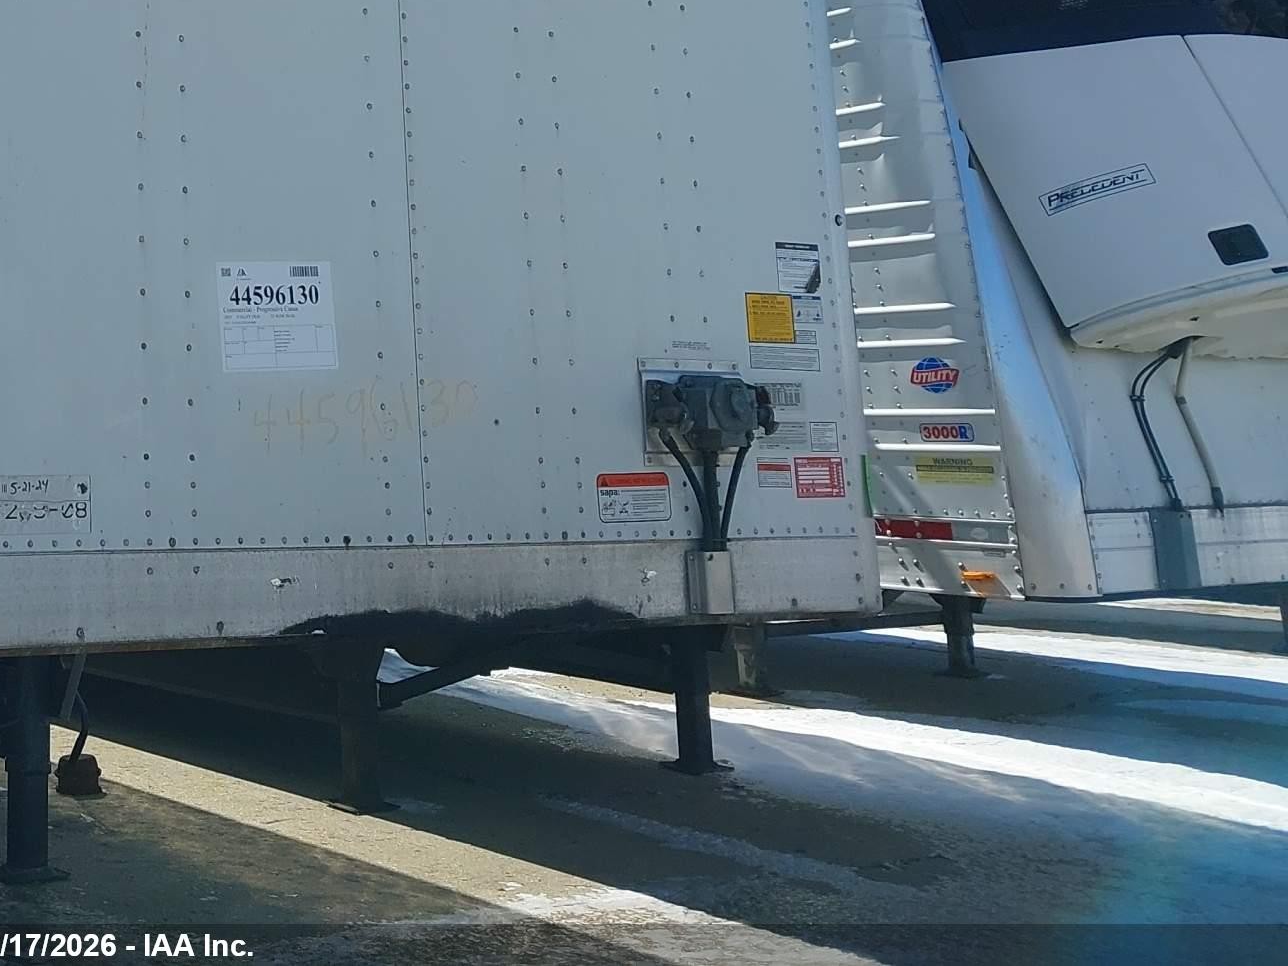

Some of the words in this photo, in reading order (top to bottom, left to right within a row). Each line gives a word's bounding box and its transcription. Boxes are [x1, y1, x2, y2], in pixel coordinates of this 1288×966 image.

[1047, 169, 1145, 207] PRECEDENT
[229, 285, 319, 306] 44596130
[913, 369, 956, 383] UTILITY
[922, 425, 969, 440] 3000R
